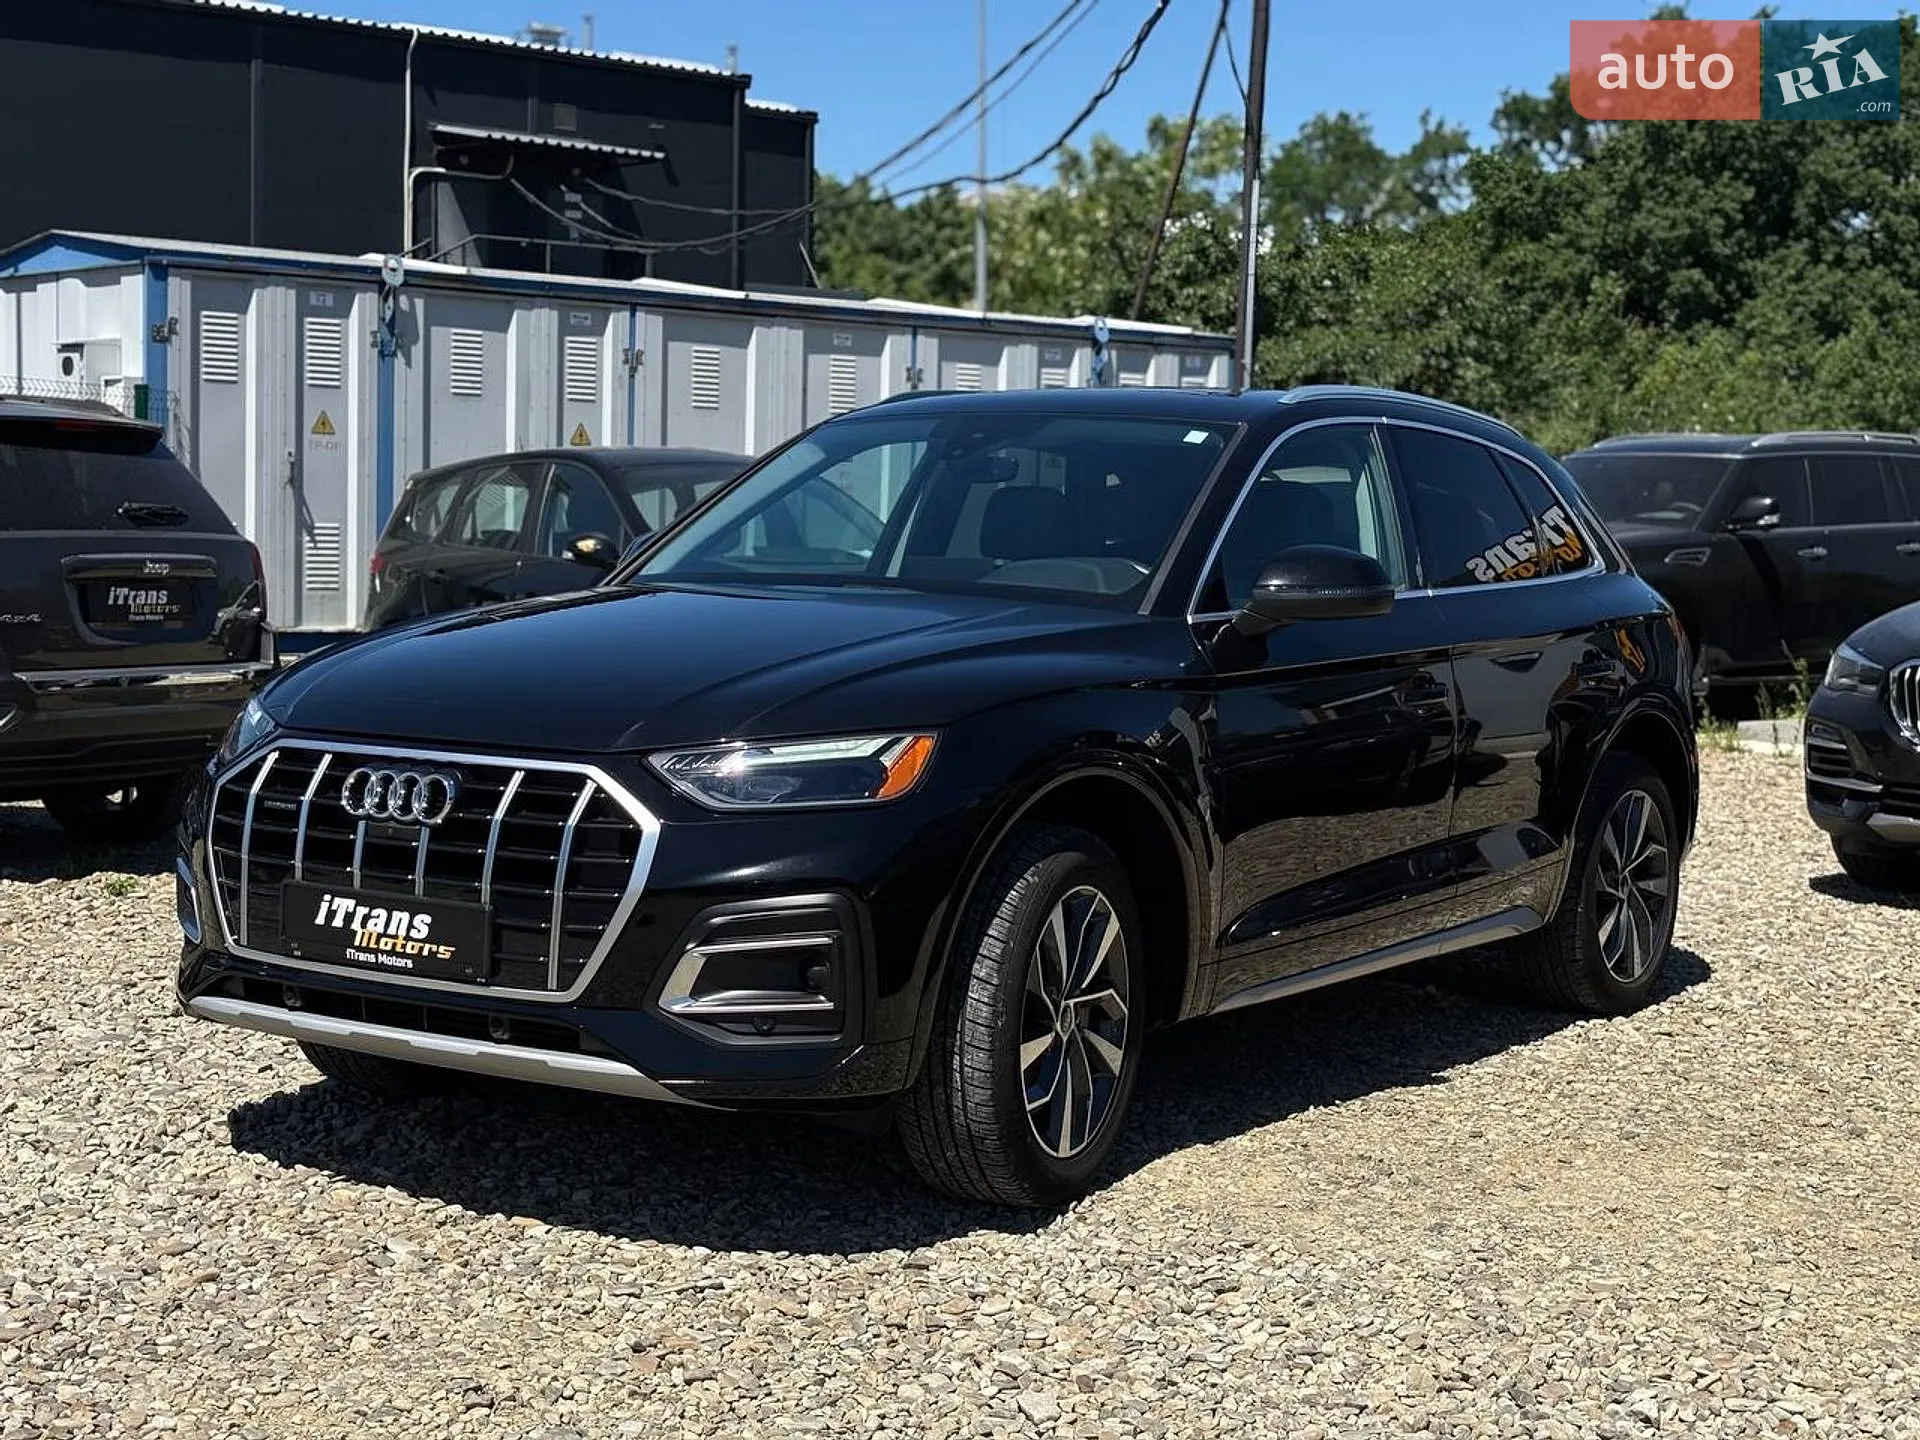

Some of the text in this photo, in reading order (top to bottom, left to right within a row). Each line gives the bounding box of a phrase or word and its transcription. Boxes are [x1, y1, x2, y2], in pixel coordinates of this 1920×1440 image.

[108, 586, 168, 605] iTrans
[314, 894, 432, 939] iTrans
[353, 929, 456, 960] Motors
[377, 952, 413, 968] Motors
